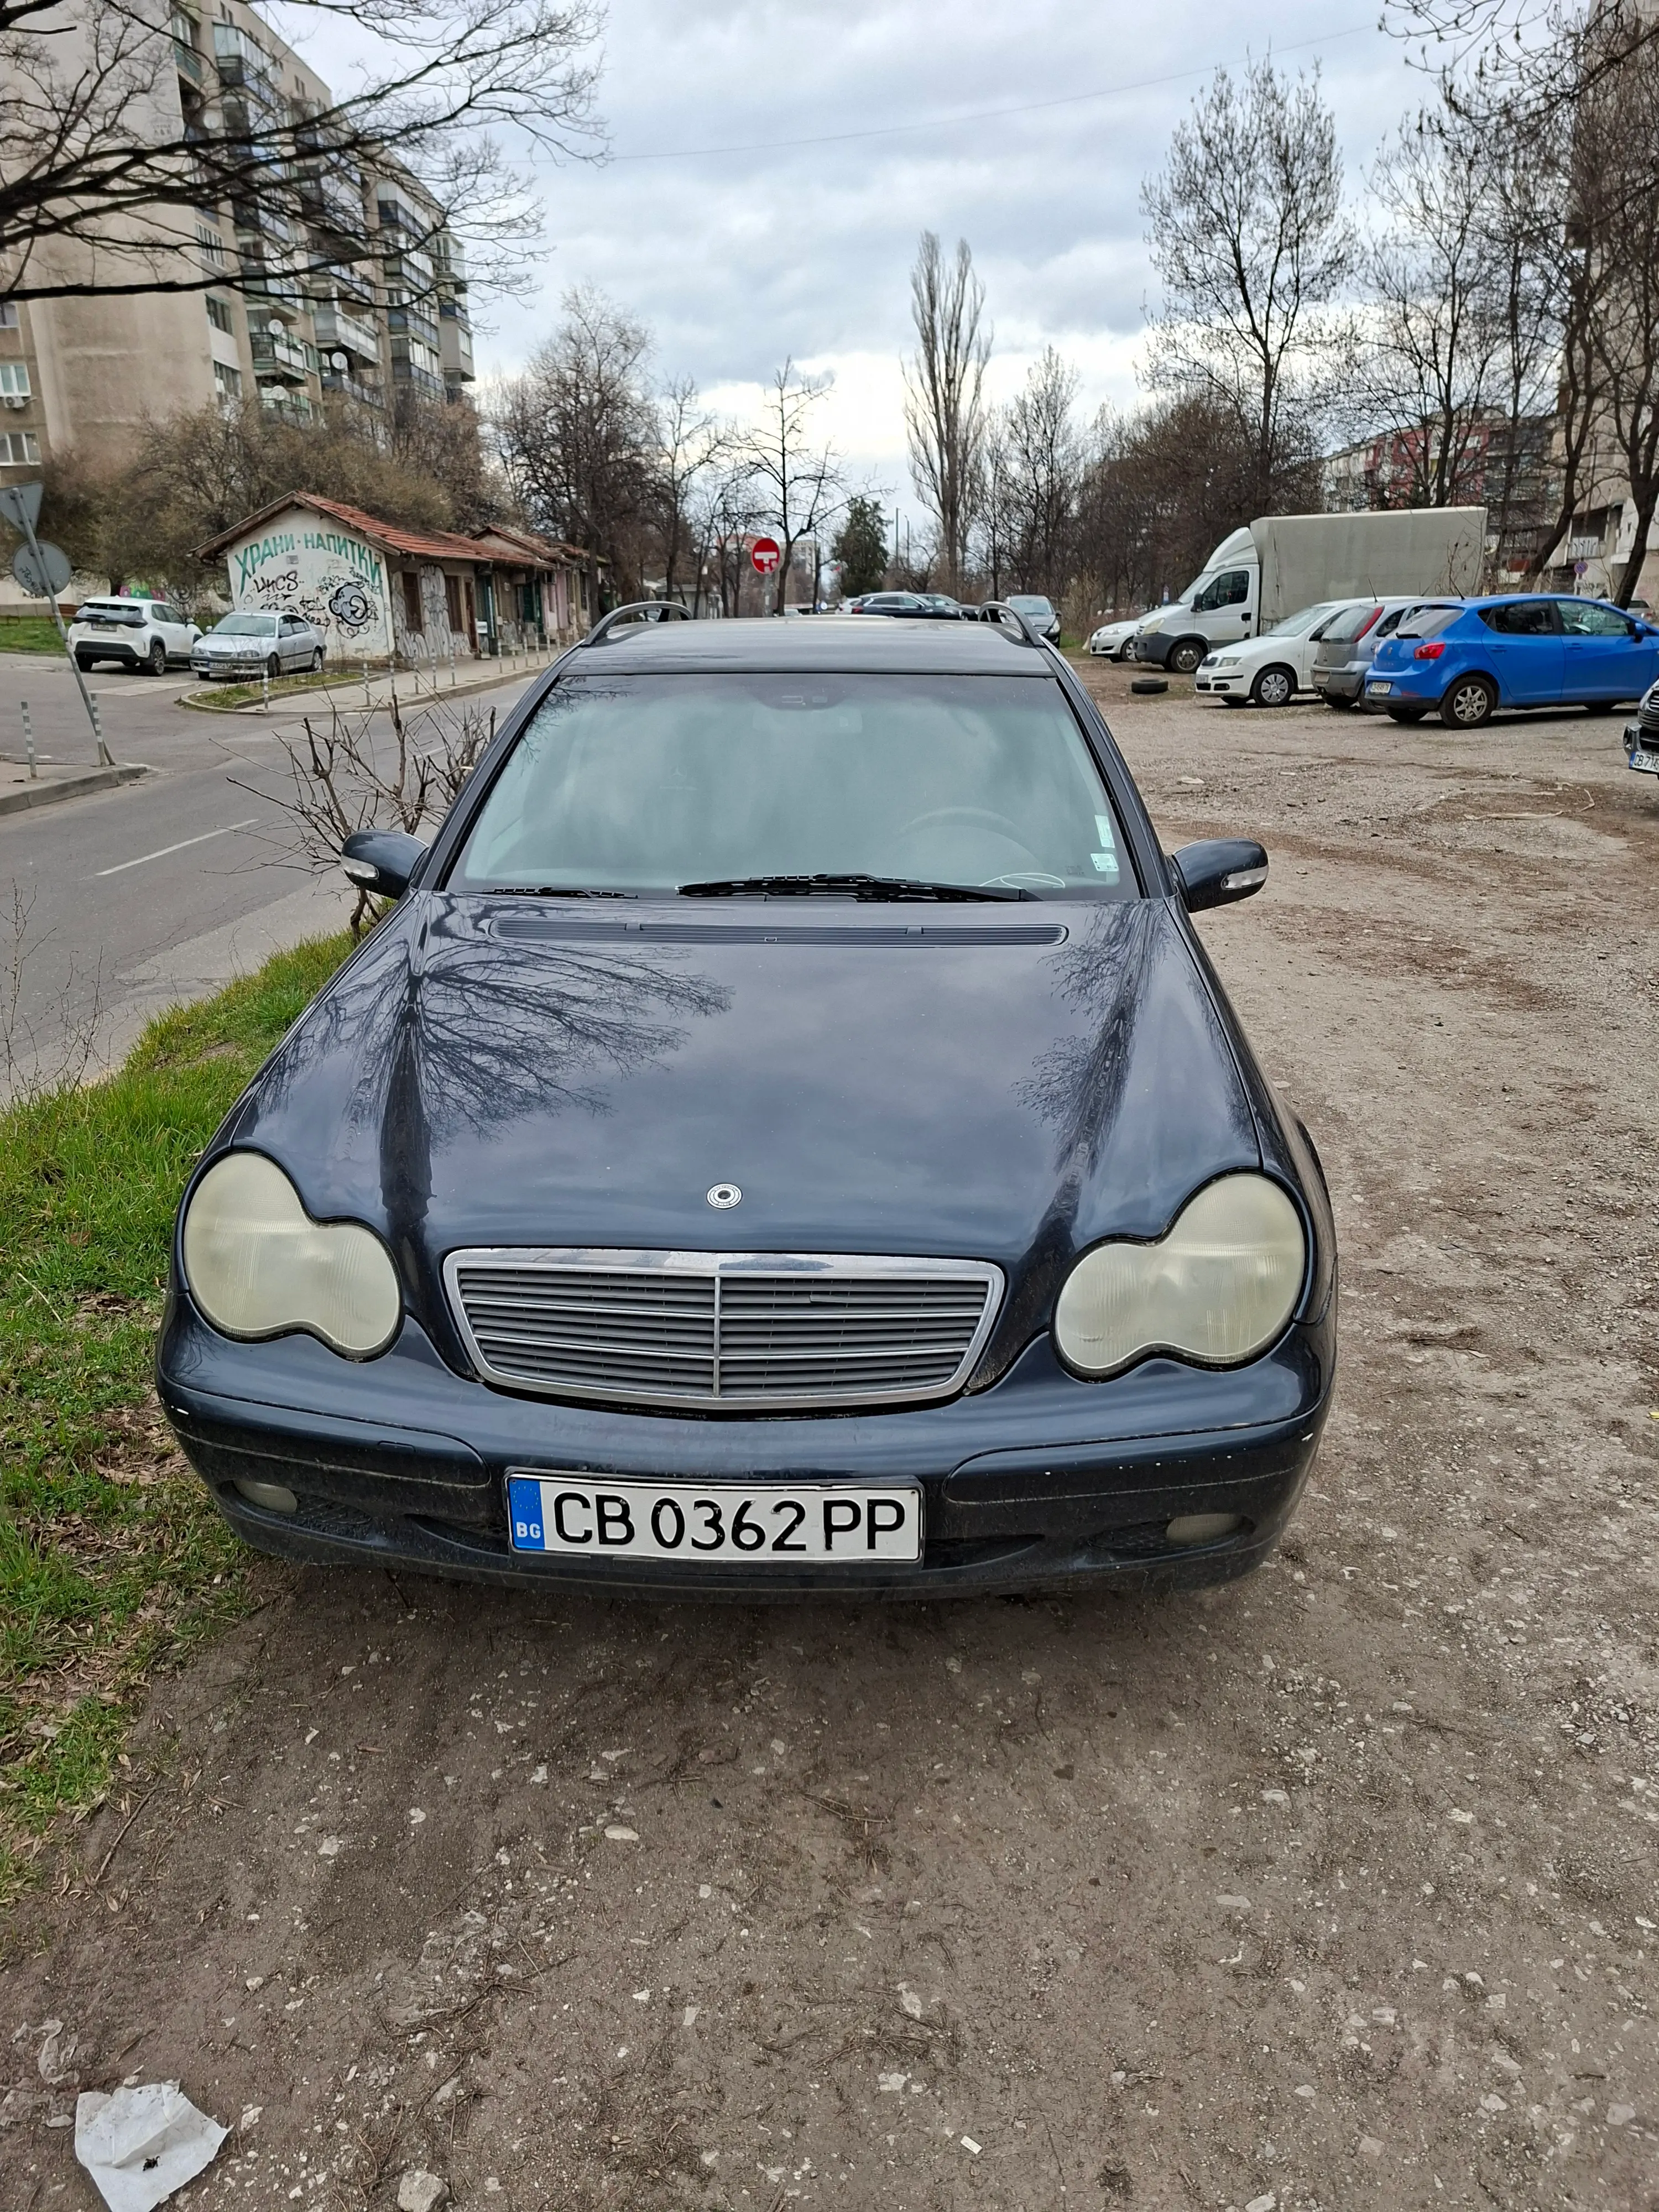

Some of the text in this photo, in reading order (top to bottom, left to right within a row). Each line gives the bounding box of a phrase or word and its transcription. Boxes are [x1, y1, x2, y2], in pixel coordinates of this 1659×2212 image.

[234, 534, 295, 598] ХРАНИ
[304, 532, 384, 598] НАПИТКИ
[516, 1521, 541, 1539] BG
[554, 1491, 906, 1551] CB 0362 PP
